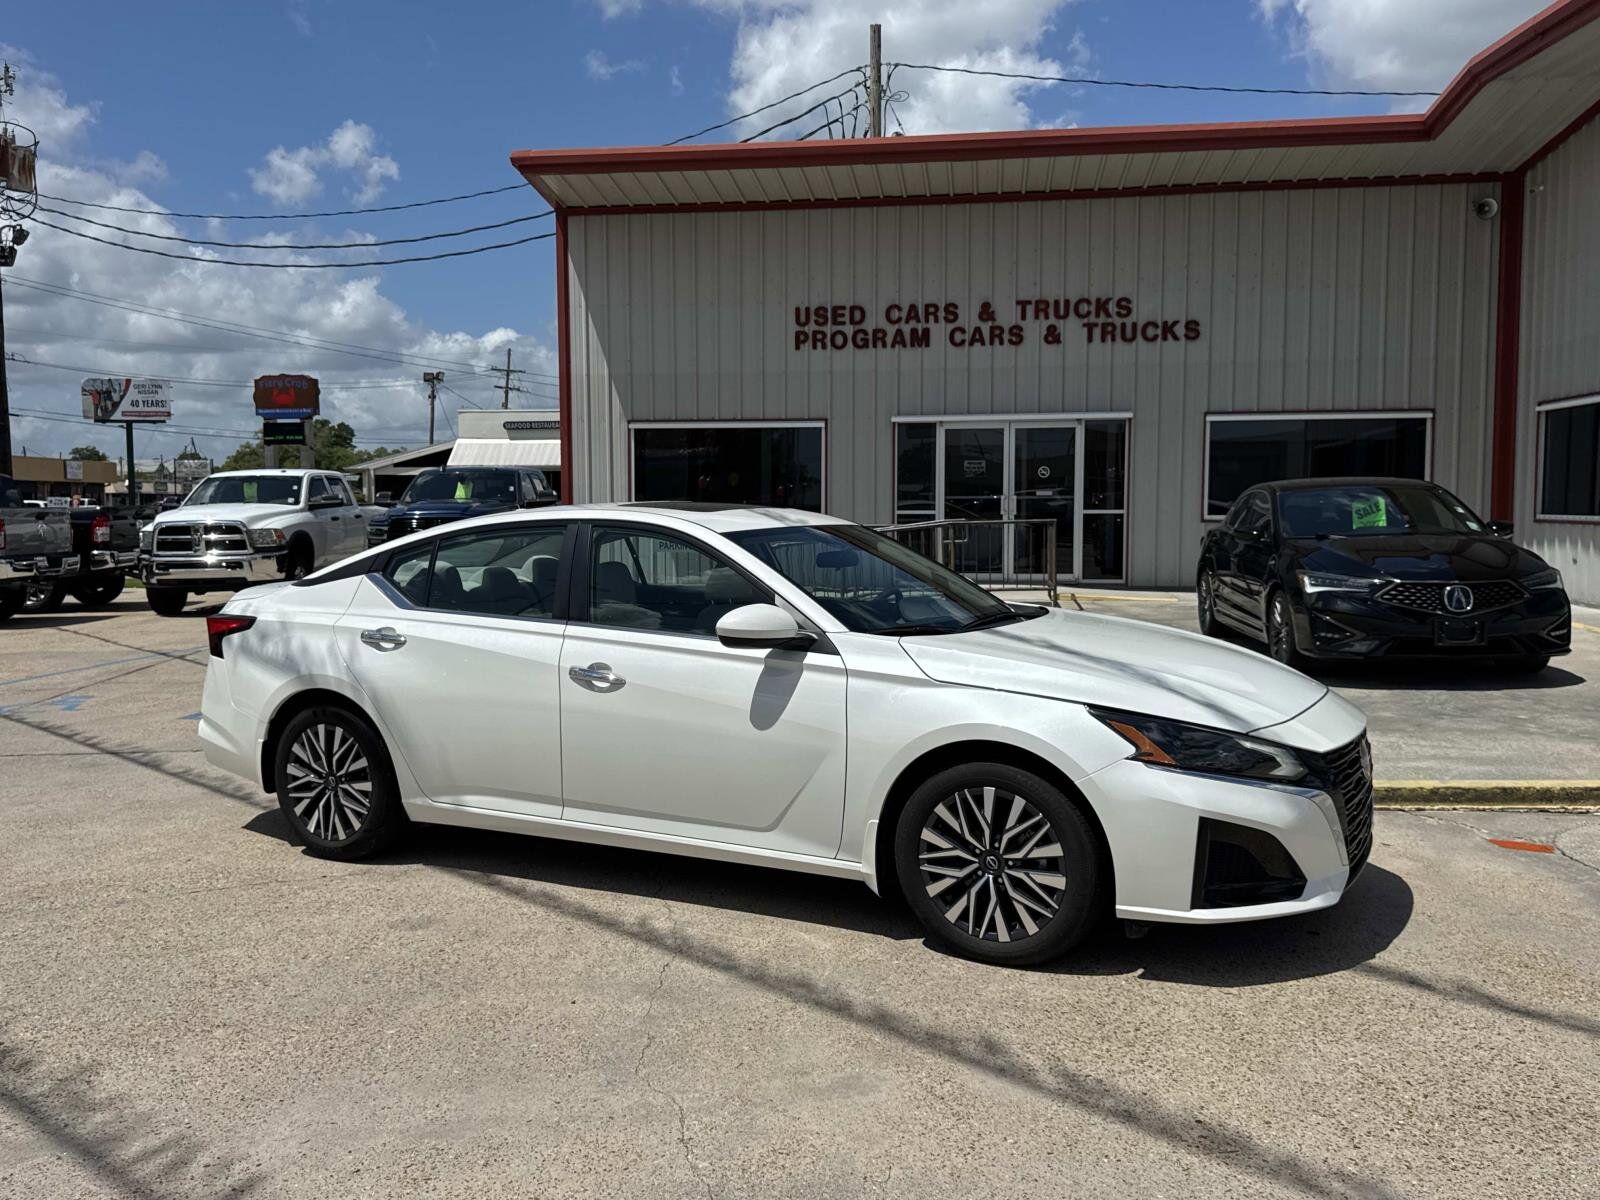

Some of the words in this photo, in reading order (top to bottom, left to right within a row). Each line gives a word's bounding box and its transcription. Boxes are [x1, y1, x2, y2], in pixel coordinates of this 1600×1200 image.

[794, 305, 866, 327] USED
[885, 302, 959, 325] CARS
[978, 301, 996, 322] &
[1016, 297, 1133, 321] TRUCKS
[794, 327, 931, 351] PROGRAM
[949, 324, 1024, 347] CARS
[1043, 324, 1062, 345] &
[1082, 320, 1201, 343] TRUCKS
[130, 400, 140, 408] 40
[1354, 501, 1382, 519] SALE
